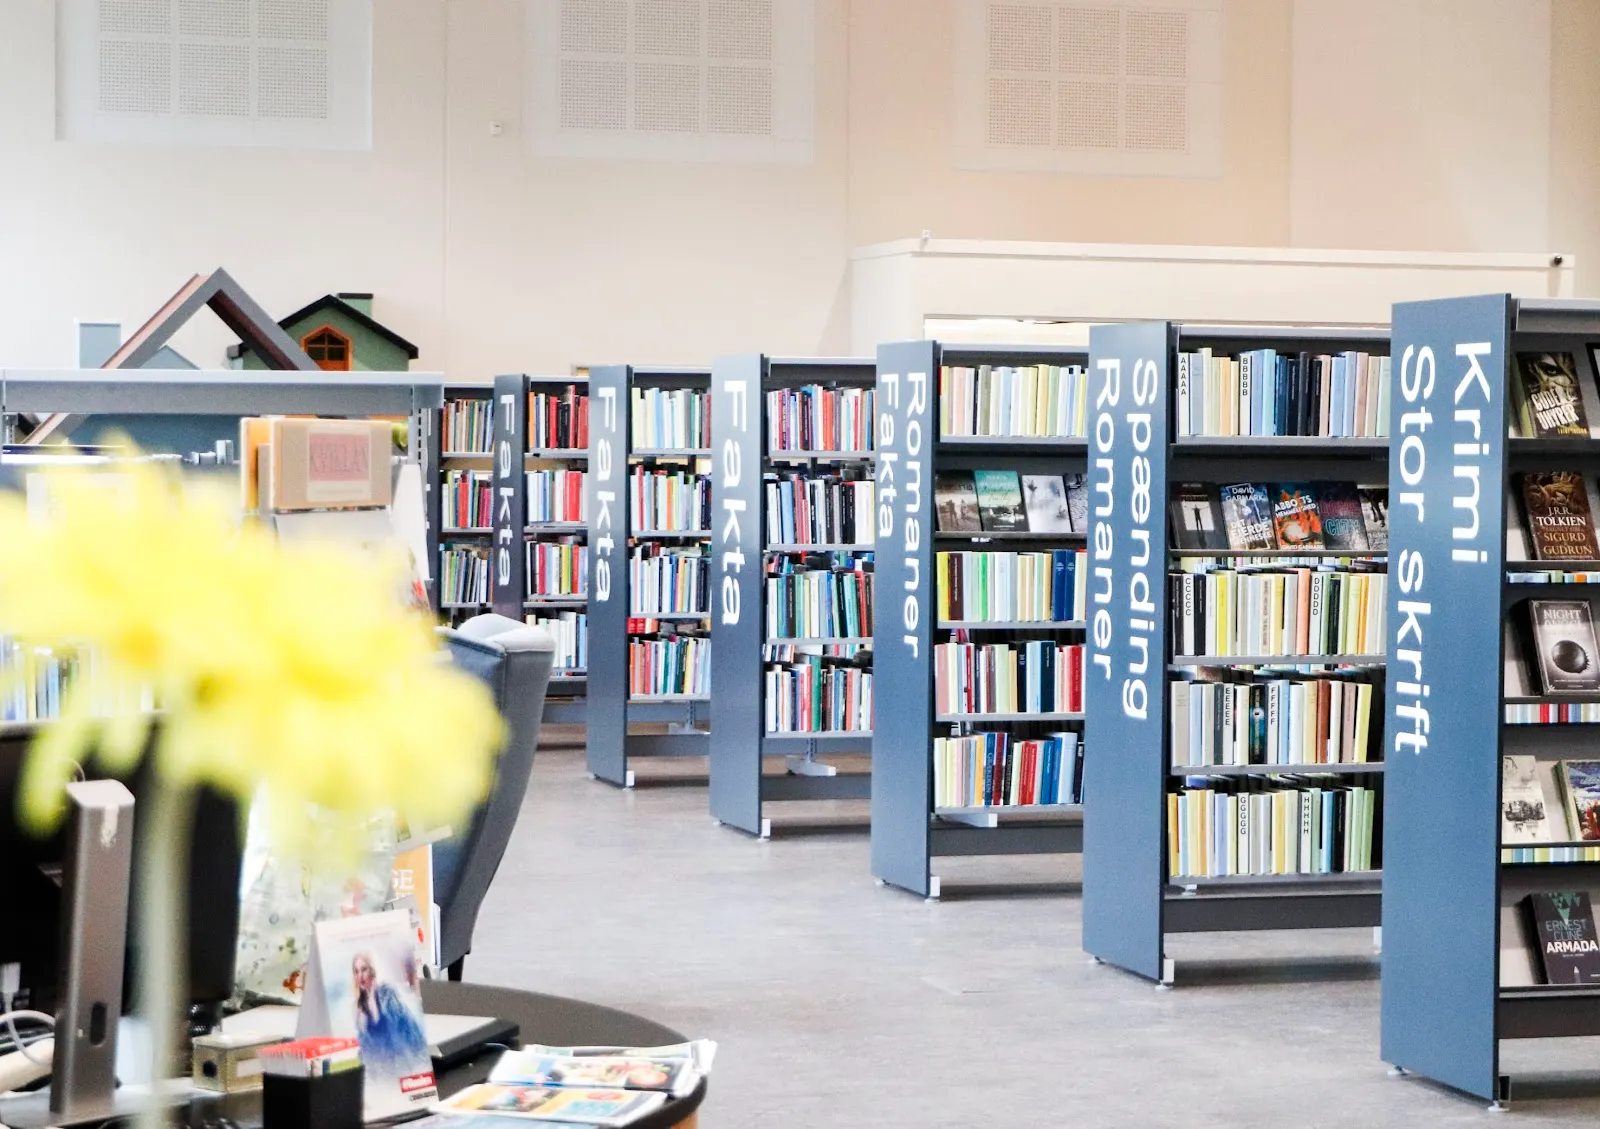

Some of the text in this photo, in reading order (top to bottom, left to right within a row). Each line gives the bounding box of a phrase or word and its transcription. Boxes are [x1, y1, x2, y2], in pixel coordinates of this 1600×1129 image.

[499, 394, 516, 586] Fakta
[596, 387, 617, 601] Fakta
[722, 380, 748, 625] Fakta
[879, 372, 900, 538] Fakta
[904, 371, 927, 658] Romaner
[1094, 357, 1121, 680] Romaner
[1122, 356, 1159, 720] Spænding
[1452, 341, 1492, 563] Krimi
[1536, 516, 1587, 526] TOLKIEN
[1543, 532, 1586, 542] SIGURD
[1395, 344, 1436, 754] Stor skrift
[1543, 545, 1593, 555] GUDRUN
[1543, 609, 1581, 620] NIGHT
[1545, 919, 1587, 931] ERNEST
[1546, 940, 1599, 954] ARMADA
